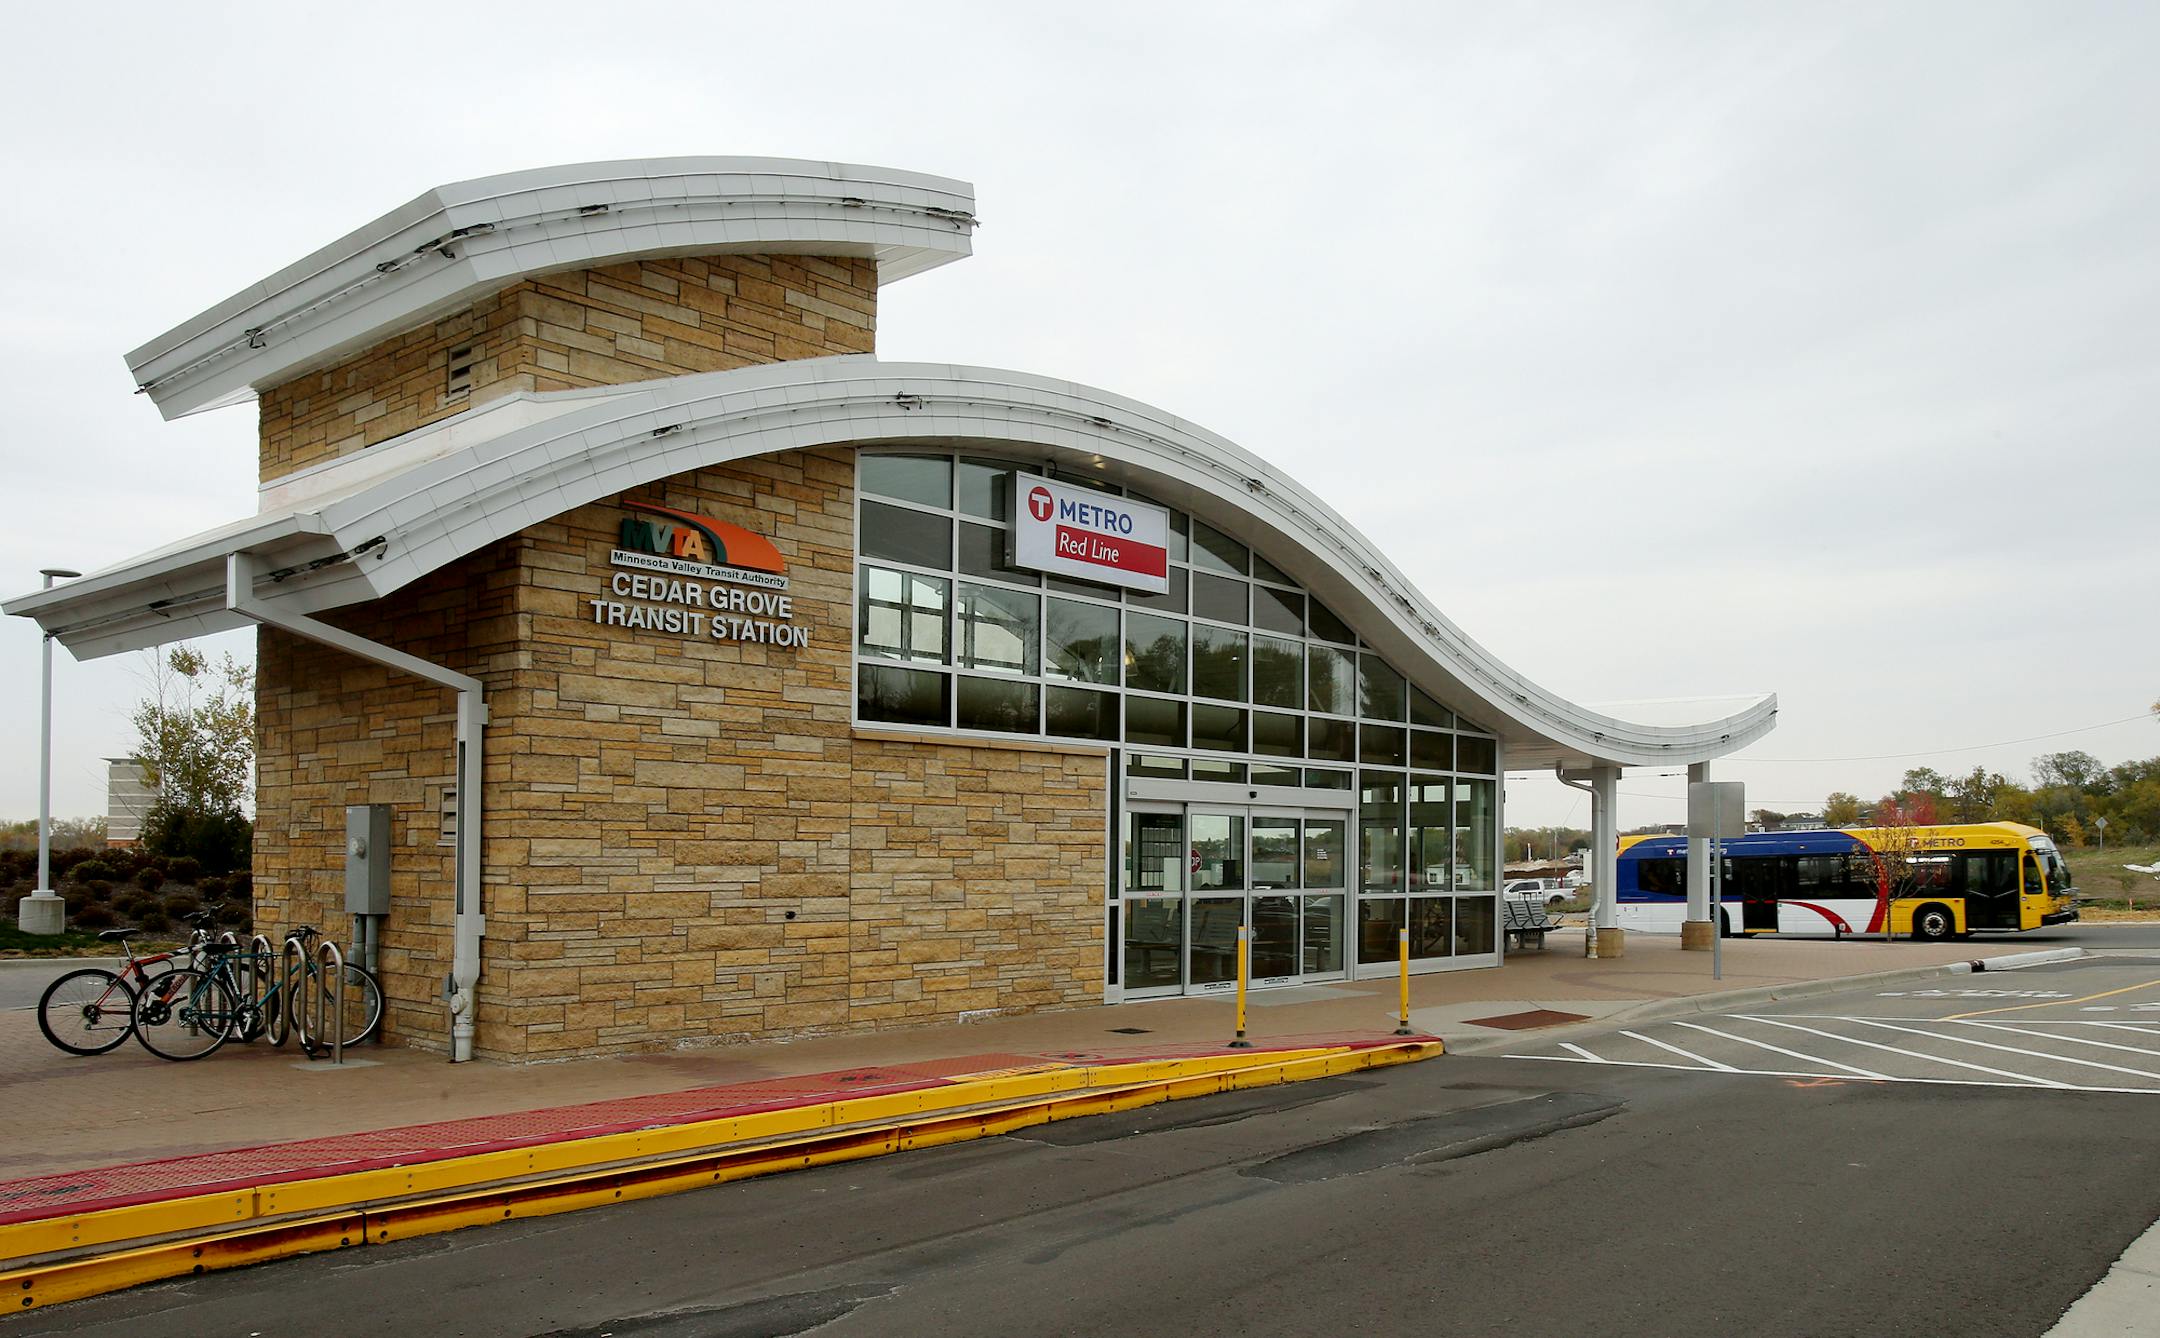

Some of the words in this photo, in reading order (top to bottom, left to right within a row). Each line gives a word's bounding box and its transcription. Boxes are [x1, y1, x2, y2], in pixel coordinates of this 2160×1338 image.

[1032, 493, 1050, 517] T
[1060, 499, 1132, 534] METRO
[621, 518, 705, 560] MVTA
[1059, 532, 1087, 556] Red
[1092, 539, 1120, 563] Line
[613, 552, 669, 569] Minnesota
[672, 561, 702, 575] Valley
[705, 566, 740, 580] Transit
[742, 573, 786, 588] Authority
[612, 572, 702, 605] CEDAR
[709, 585, 793, 618] GROVE
[590, 600, 705, 635] TRANSIT
[711, 616, 809, 648] STATION
[1923, 838, 1965, 847] METRO
